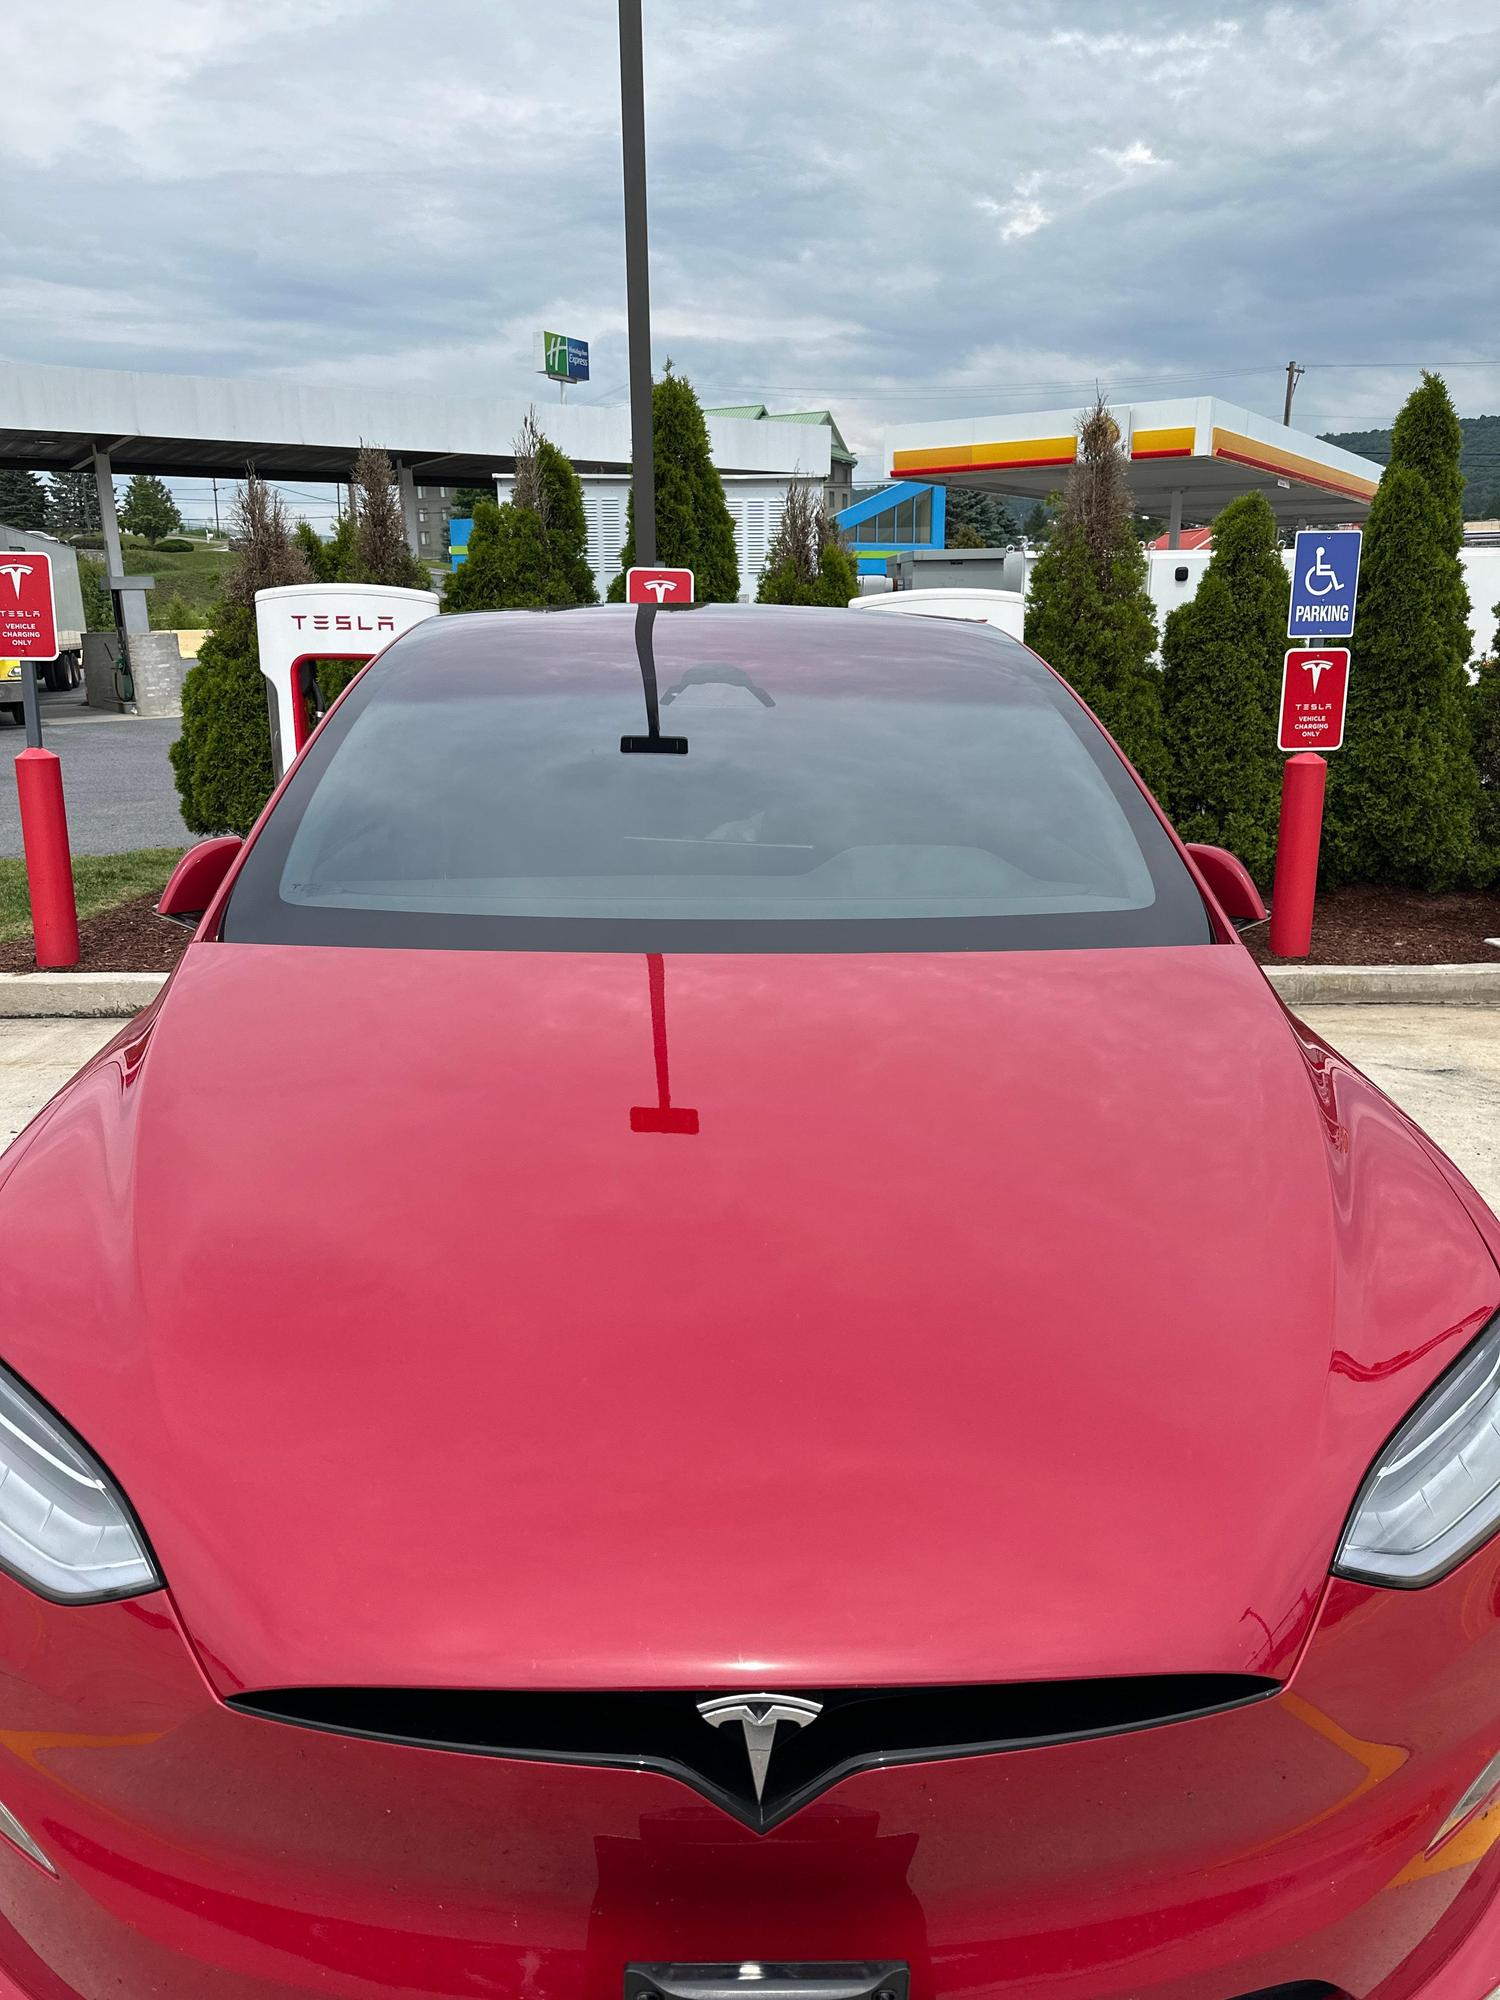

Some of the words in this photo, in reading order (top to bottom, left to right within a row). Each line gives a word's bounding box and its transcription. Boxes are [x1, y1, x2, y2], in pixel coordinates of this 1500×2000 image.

[1295, 605, 1349, 622] PARKING
[290, 615, 394, 631] TESLA
[1295, 703, 1332, 711] TESLA
